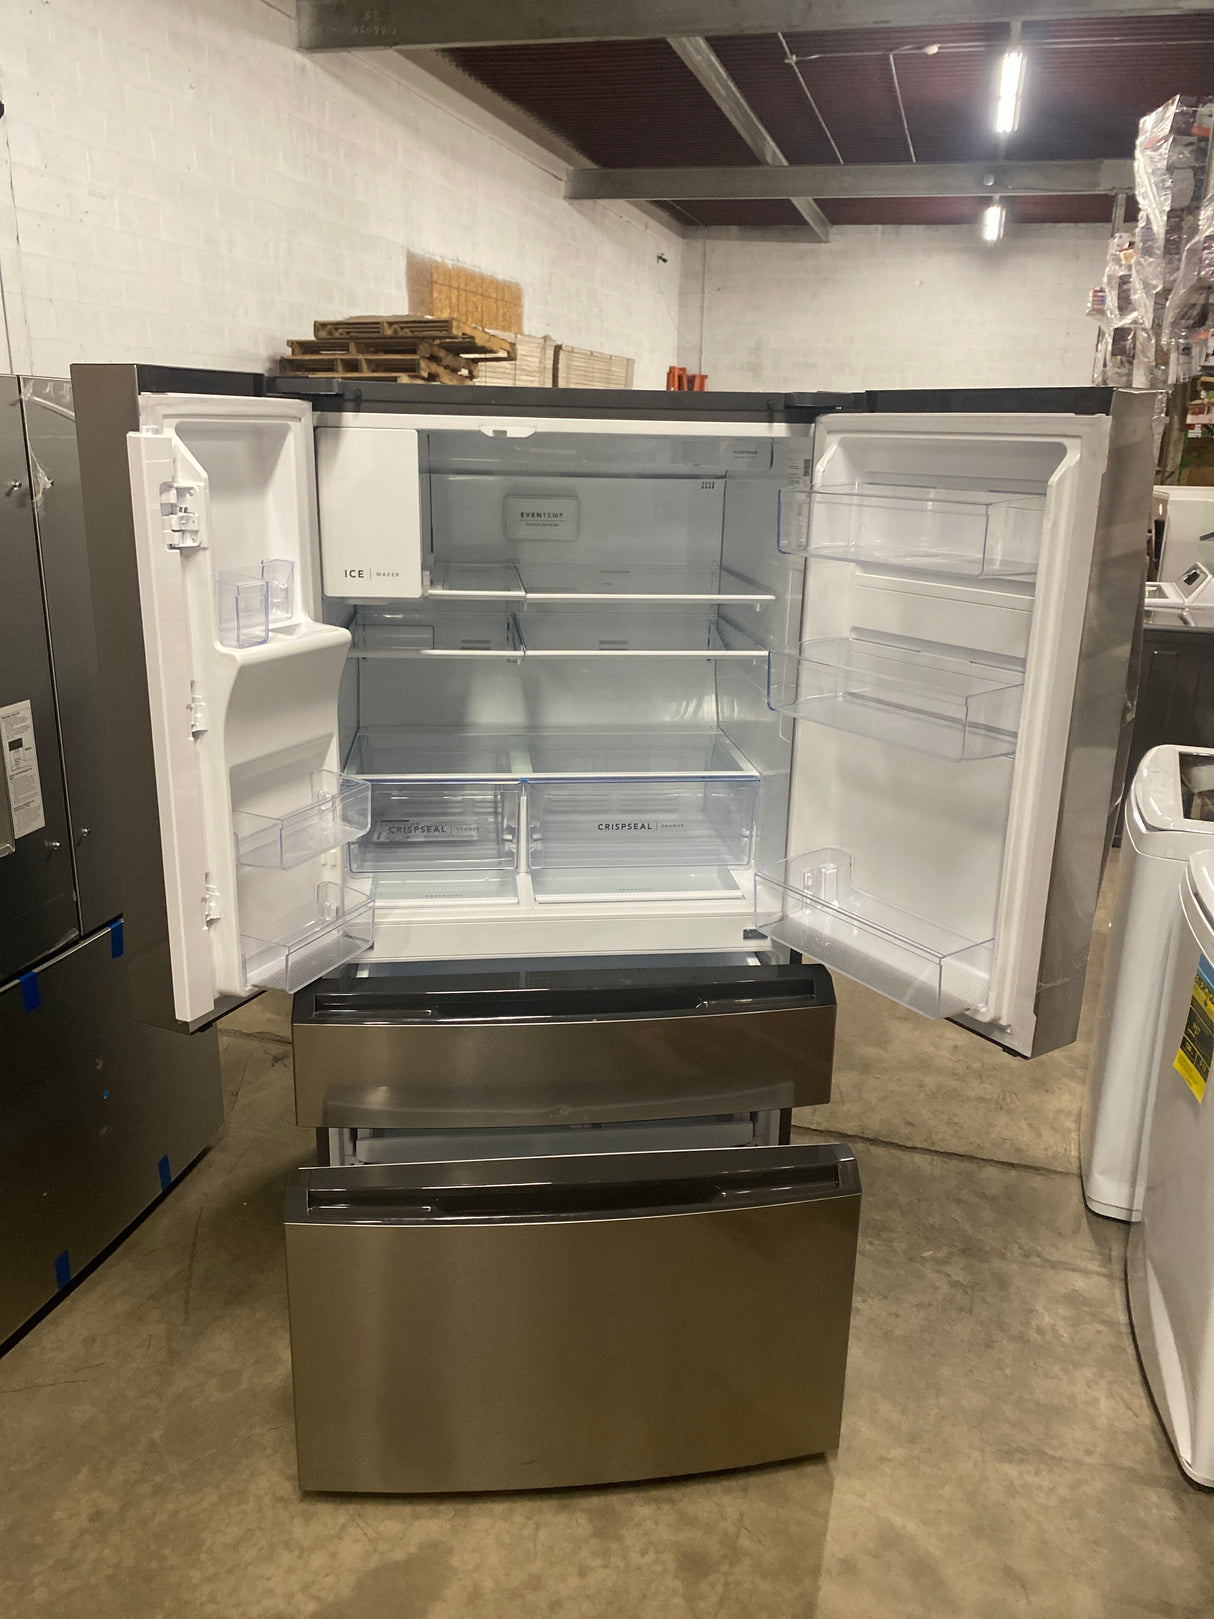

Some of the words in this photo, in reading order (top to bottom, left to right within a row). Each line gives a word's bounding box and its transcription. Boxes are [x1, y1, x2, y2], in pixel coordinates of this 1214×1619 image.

[520, 511, 564, 519] EVENTEMP
[344, 569, 365, 579] ICE
[388, 825, 447, 834] CRISPSEAL
[597, 823, 653, 831] CRISPSEAL
